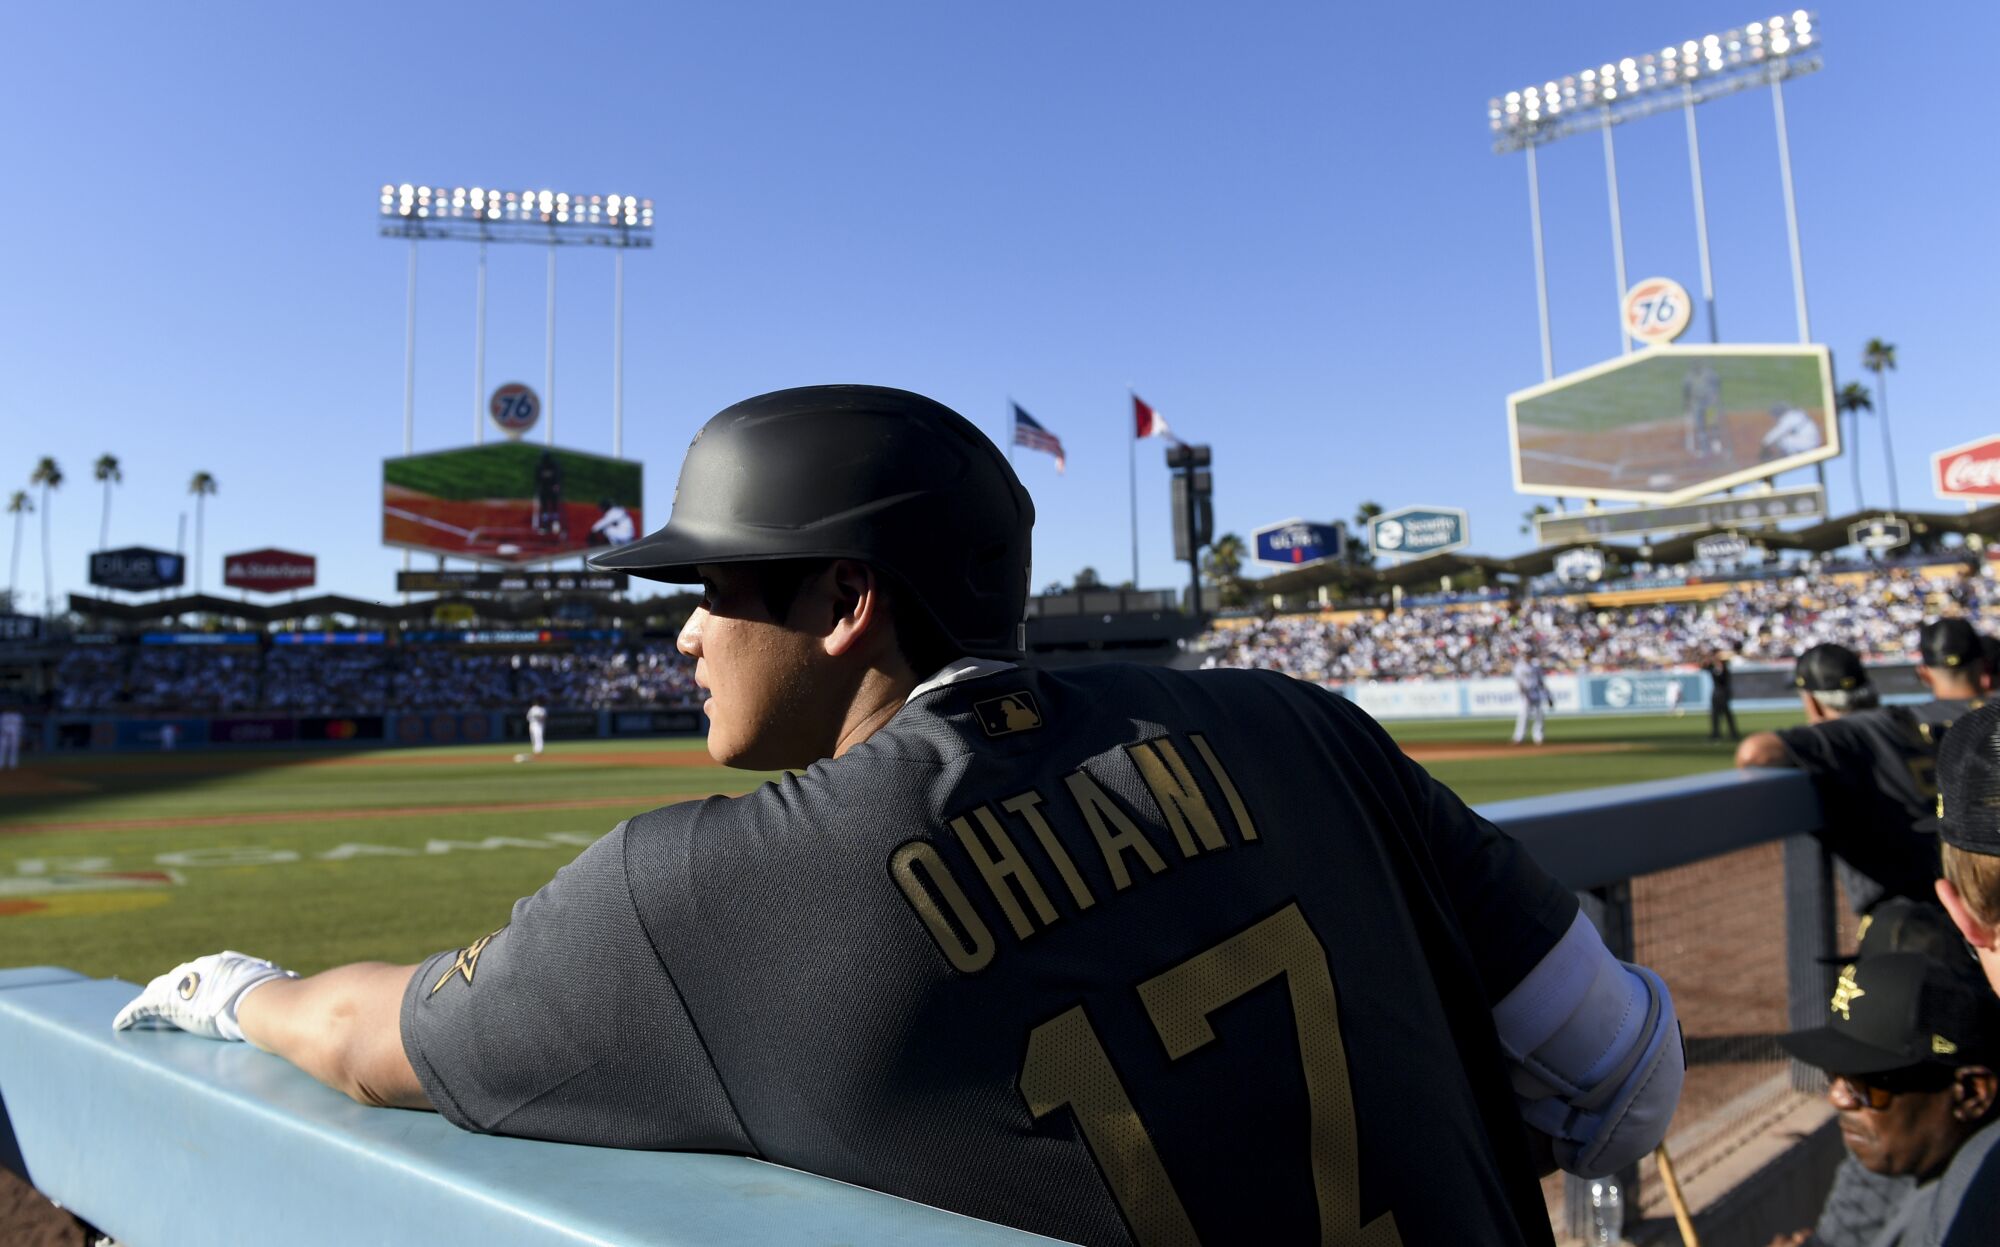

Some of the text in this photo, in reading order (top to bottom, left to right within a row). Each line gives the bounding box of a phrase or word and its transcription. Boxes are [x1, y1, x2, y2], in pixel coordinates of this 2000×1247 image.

[1637, 293, 1676, 326] 76
[501, 392, 533, 420] 76
[1404, 516, 1458, 533] Security
[1269, 531, 1323, 551] ULTRA
[1405, 531, 1451, 547] Benefit
[891, 733, 1259, 975] OHTANI
[1018, 901, 1404, 1247] 17
